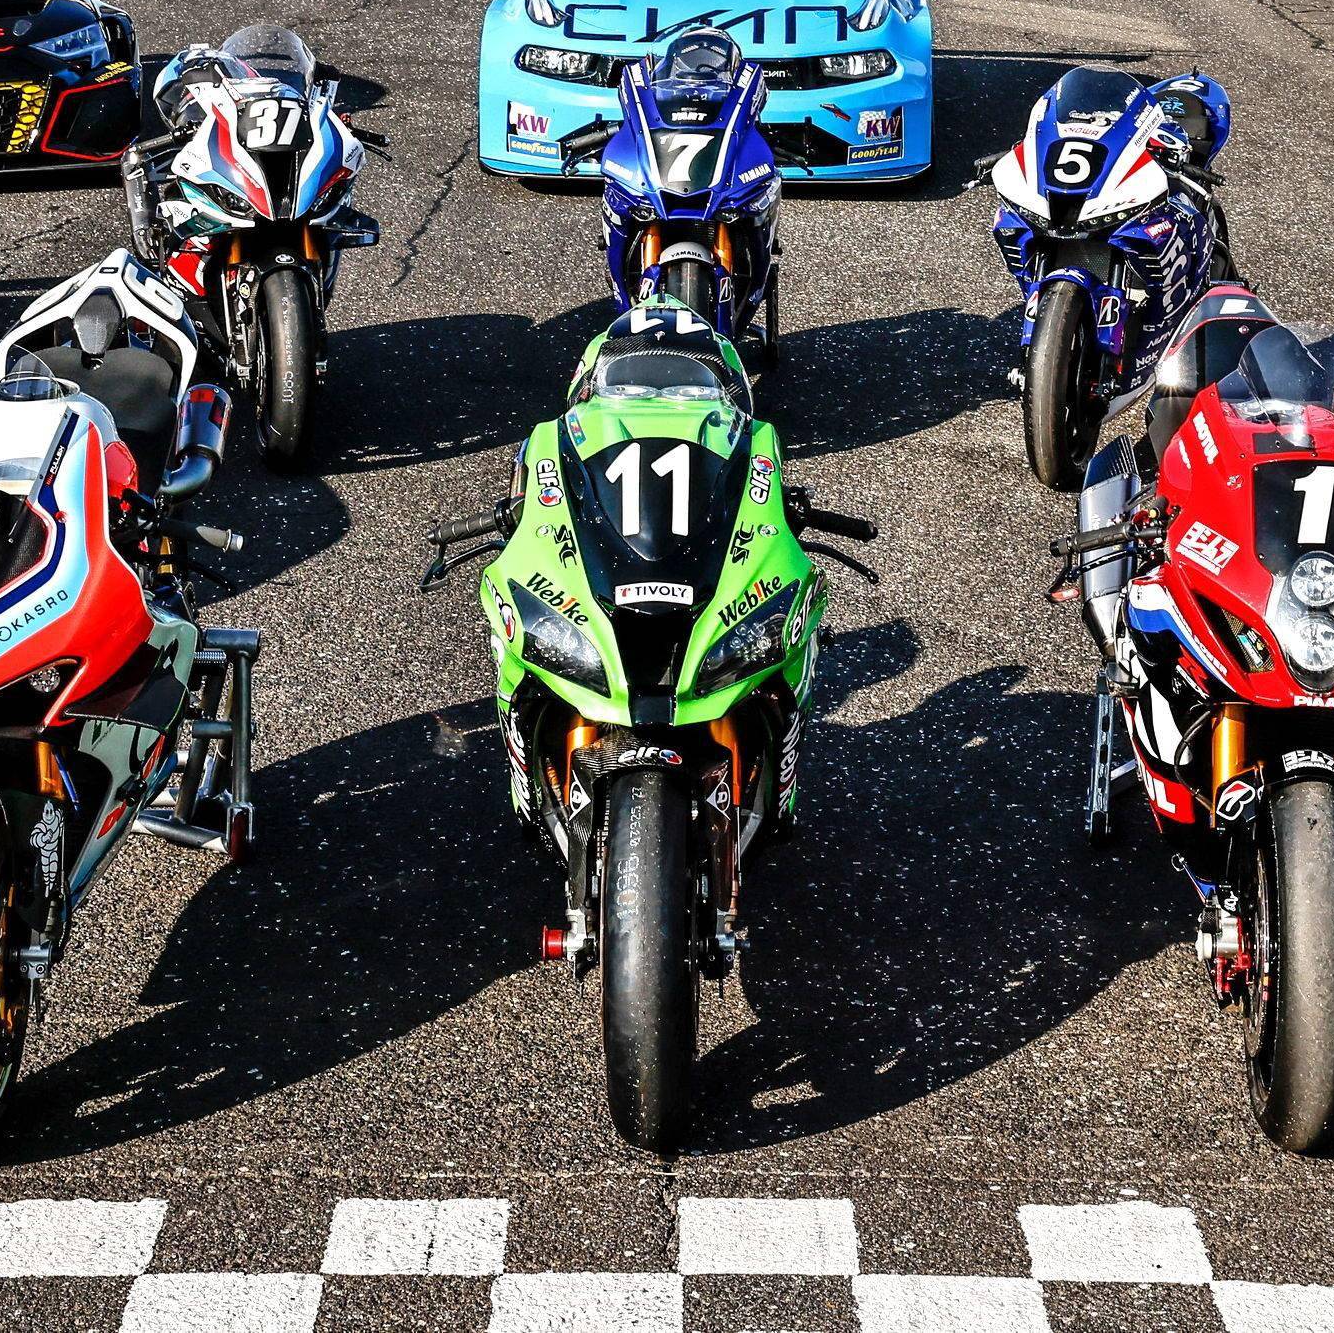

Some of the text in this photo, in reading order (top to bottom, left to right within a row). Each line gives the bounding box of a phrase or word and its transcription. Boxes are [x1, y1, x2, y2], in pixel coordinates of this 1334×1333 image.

[246, 99, 303, 149] 37
[517, 113, 549, 134] KW
[866, 116, 901, 138] KW
[668, 133, 715, 183] 7
[851, 146, 899, 159] GOODYEAR
[1053, 141, 1094, 184] 5
[738, 164, 772, 184] YAMAHA
[1149, 220, 1173, 238] MOTUL
[1135, 351, 1159, 368] NGK
[1192, 410, 1219, 465] MOTUL
[536, 458, 560, 488] elf
[605, 441, 691, 538] 11
[749, 471, 771, 505] elf
[634, 585, 689, 599] TIVOLY
[617, 747, 660, 765] elf
